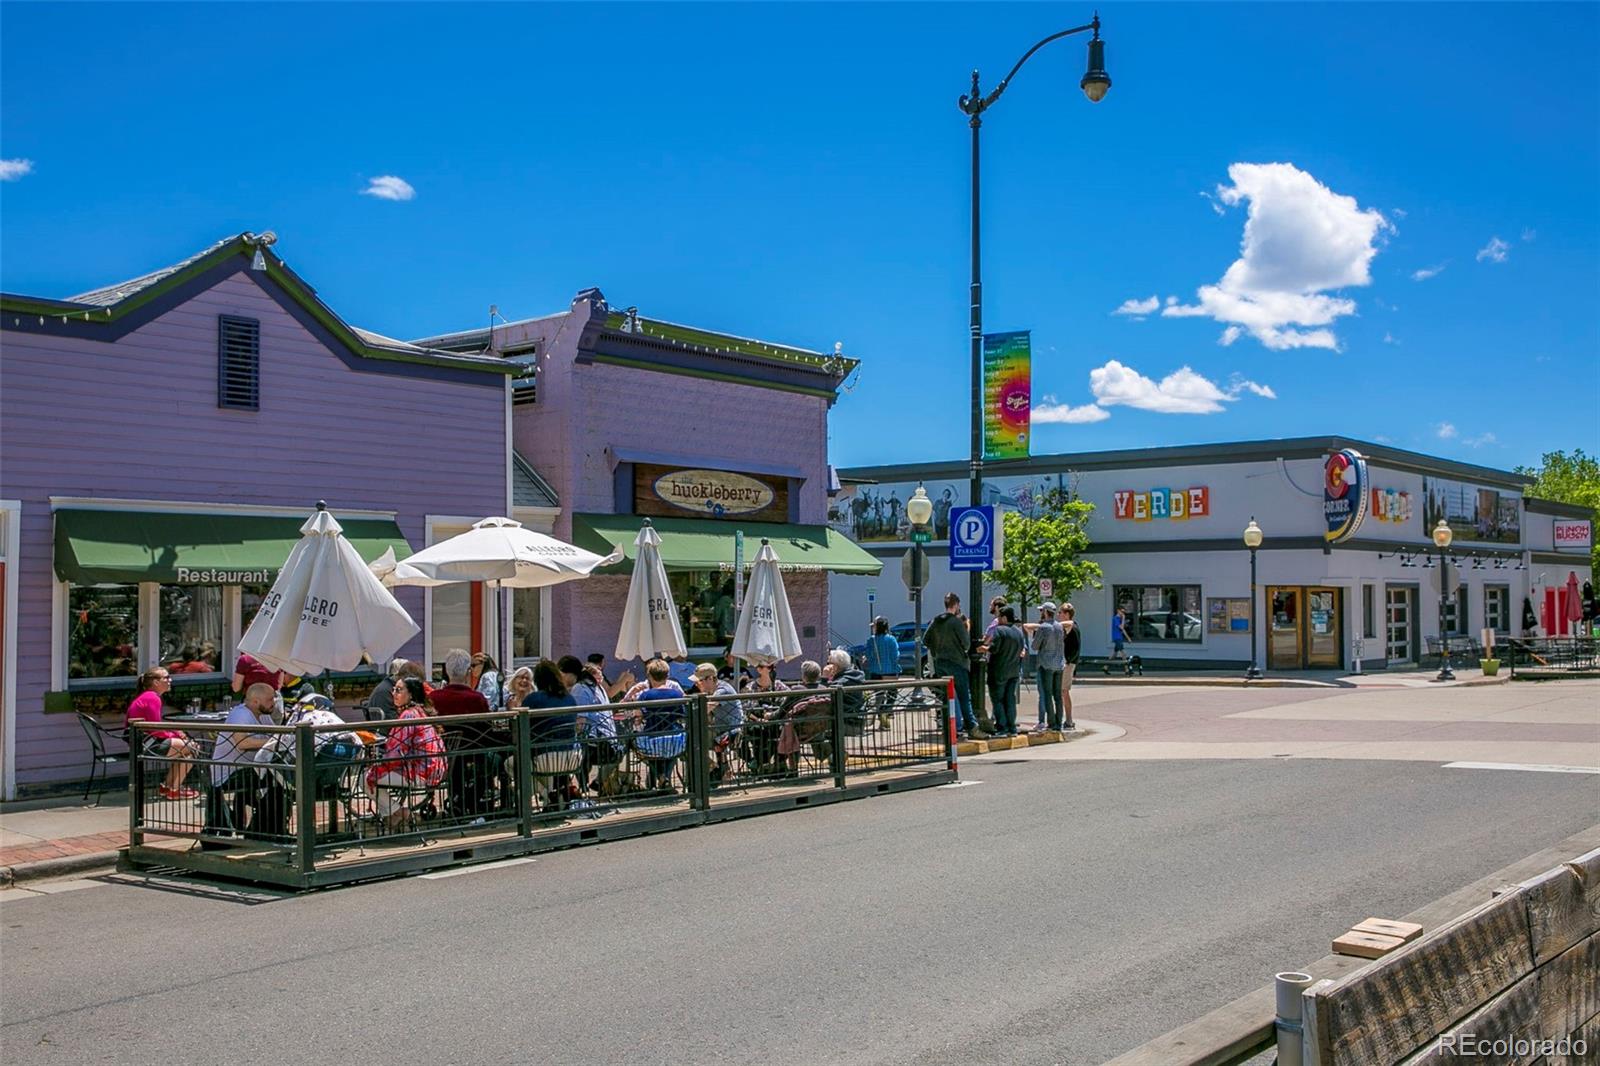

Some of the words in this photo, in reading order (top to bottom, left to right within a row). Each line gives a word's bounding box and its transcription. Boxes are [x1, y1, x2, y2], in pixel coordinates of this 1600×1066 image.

[671, 481, 761, 504] huckleberry
[1114, 488, 1204, 518] VERDE
[965, 521, 980, 540] P
[958, 547, 986, 555] PARKING
[177, 568, 269, 583] Restaurant
